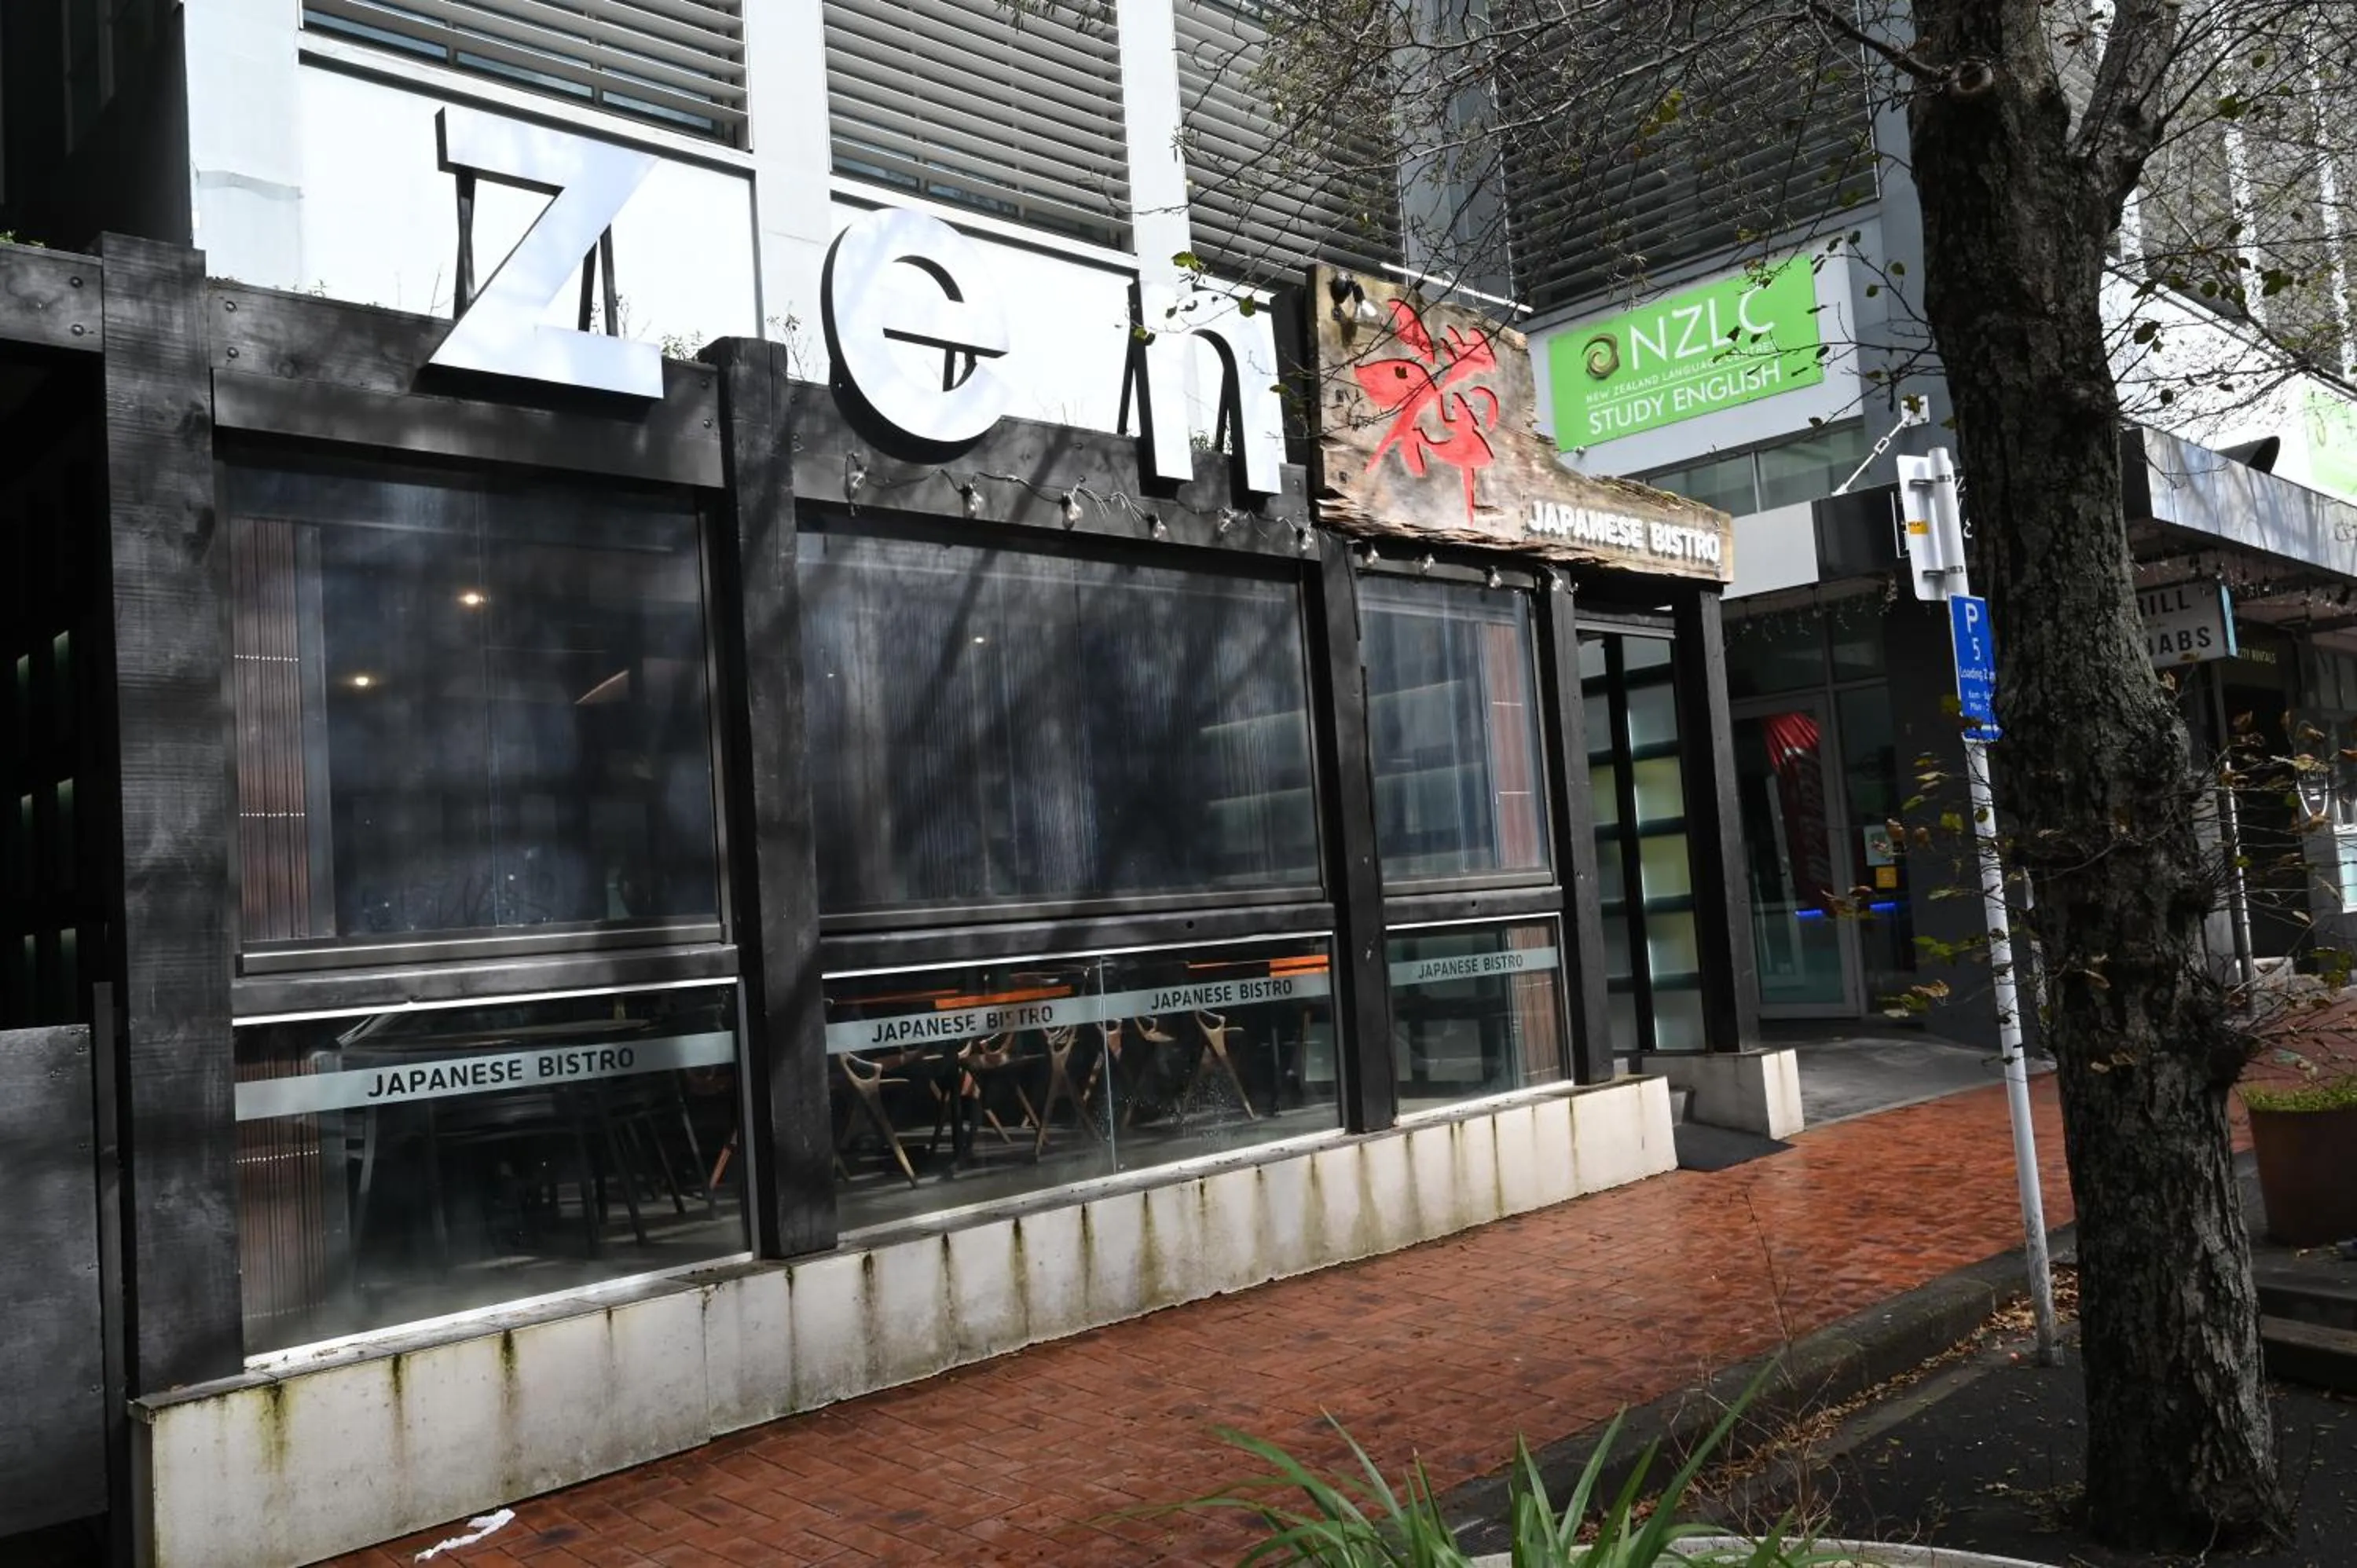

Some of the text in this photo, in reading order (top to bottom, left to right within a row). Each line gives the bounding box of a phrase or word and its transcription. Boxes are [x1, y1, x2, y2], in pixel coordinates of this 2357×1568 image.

[1629, 285, 1775, 370] NZLC
[1586, 390, 1611, 403] NEW
[1613, 375, 1659, 396] ZEALAND
[1589, 358, 1781, 435] STUDY ENGLISH
[1530, 500, 1720, 562] JAPANESE BISTRO
[1965, 603, 1978, 633] P
[1972, 637, 1981, 661] 5
[1419, 954, 1523, 979] JAPANESE BISTRO
[1151, 980, 1292, 1010] JAPANESE BISTRO
[872, 1014, 977, 1042] JAPANESE
[368, 1047, 634, 1097] JAPANESE BISTRO
